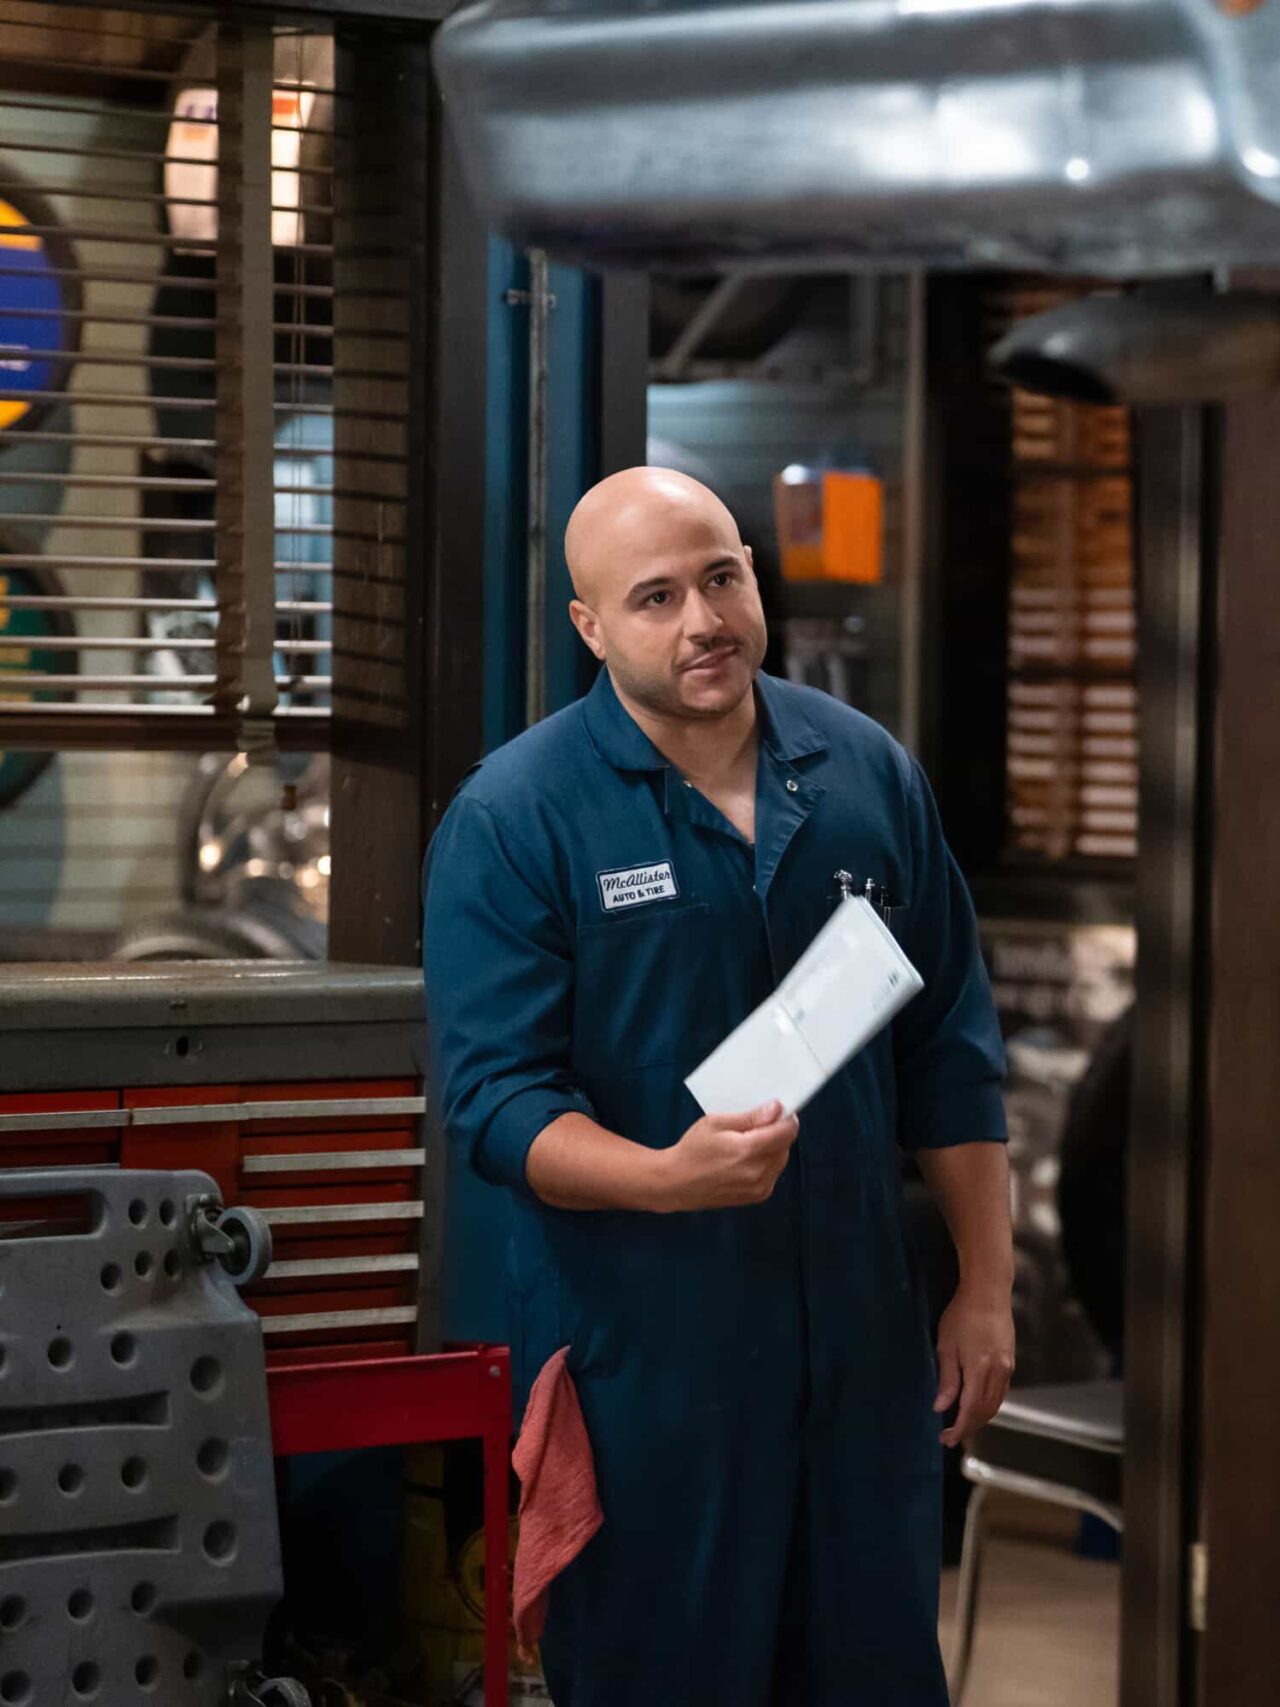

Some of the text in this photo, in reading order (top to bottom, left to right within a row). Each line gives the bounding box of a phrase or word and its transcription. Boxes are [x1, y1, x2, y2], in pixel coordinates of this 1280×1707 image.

[603, 870, 670, 892] McAllister
[613, 885, 666, 903] AUTO & TIRE
